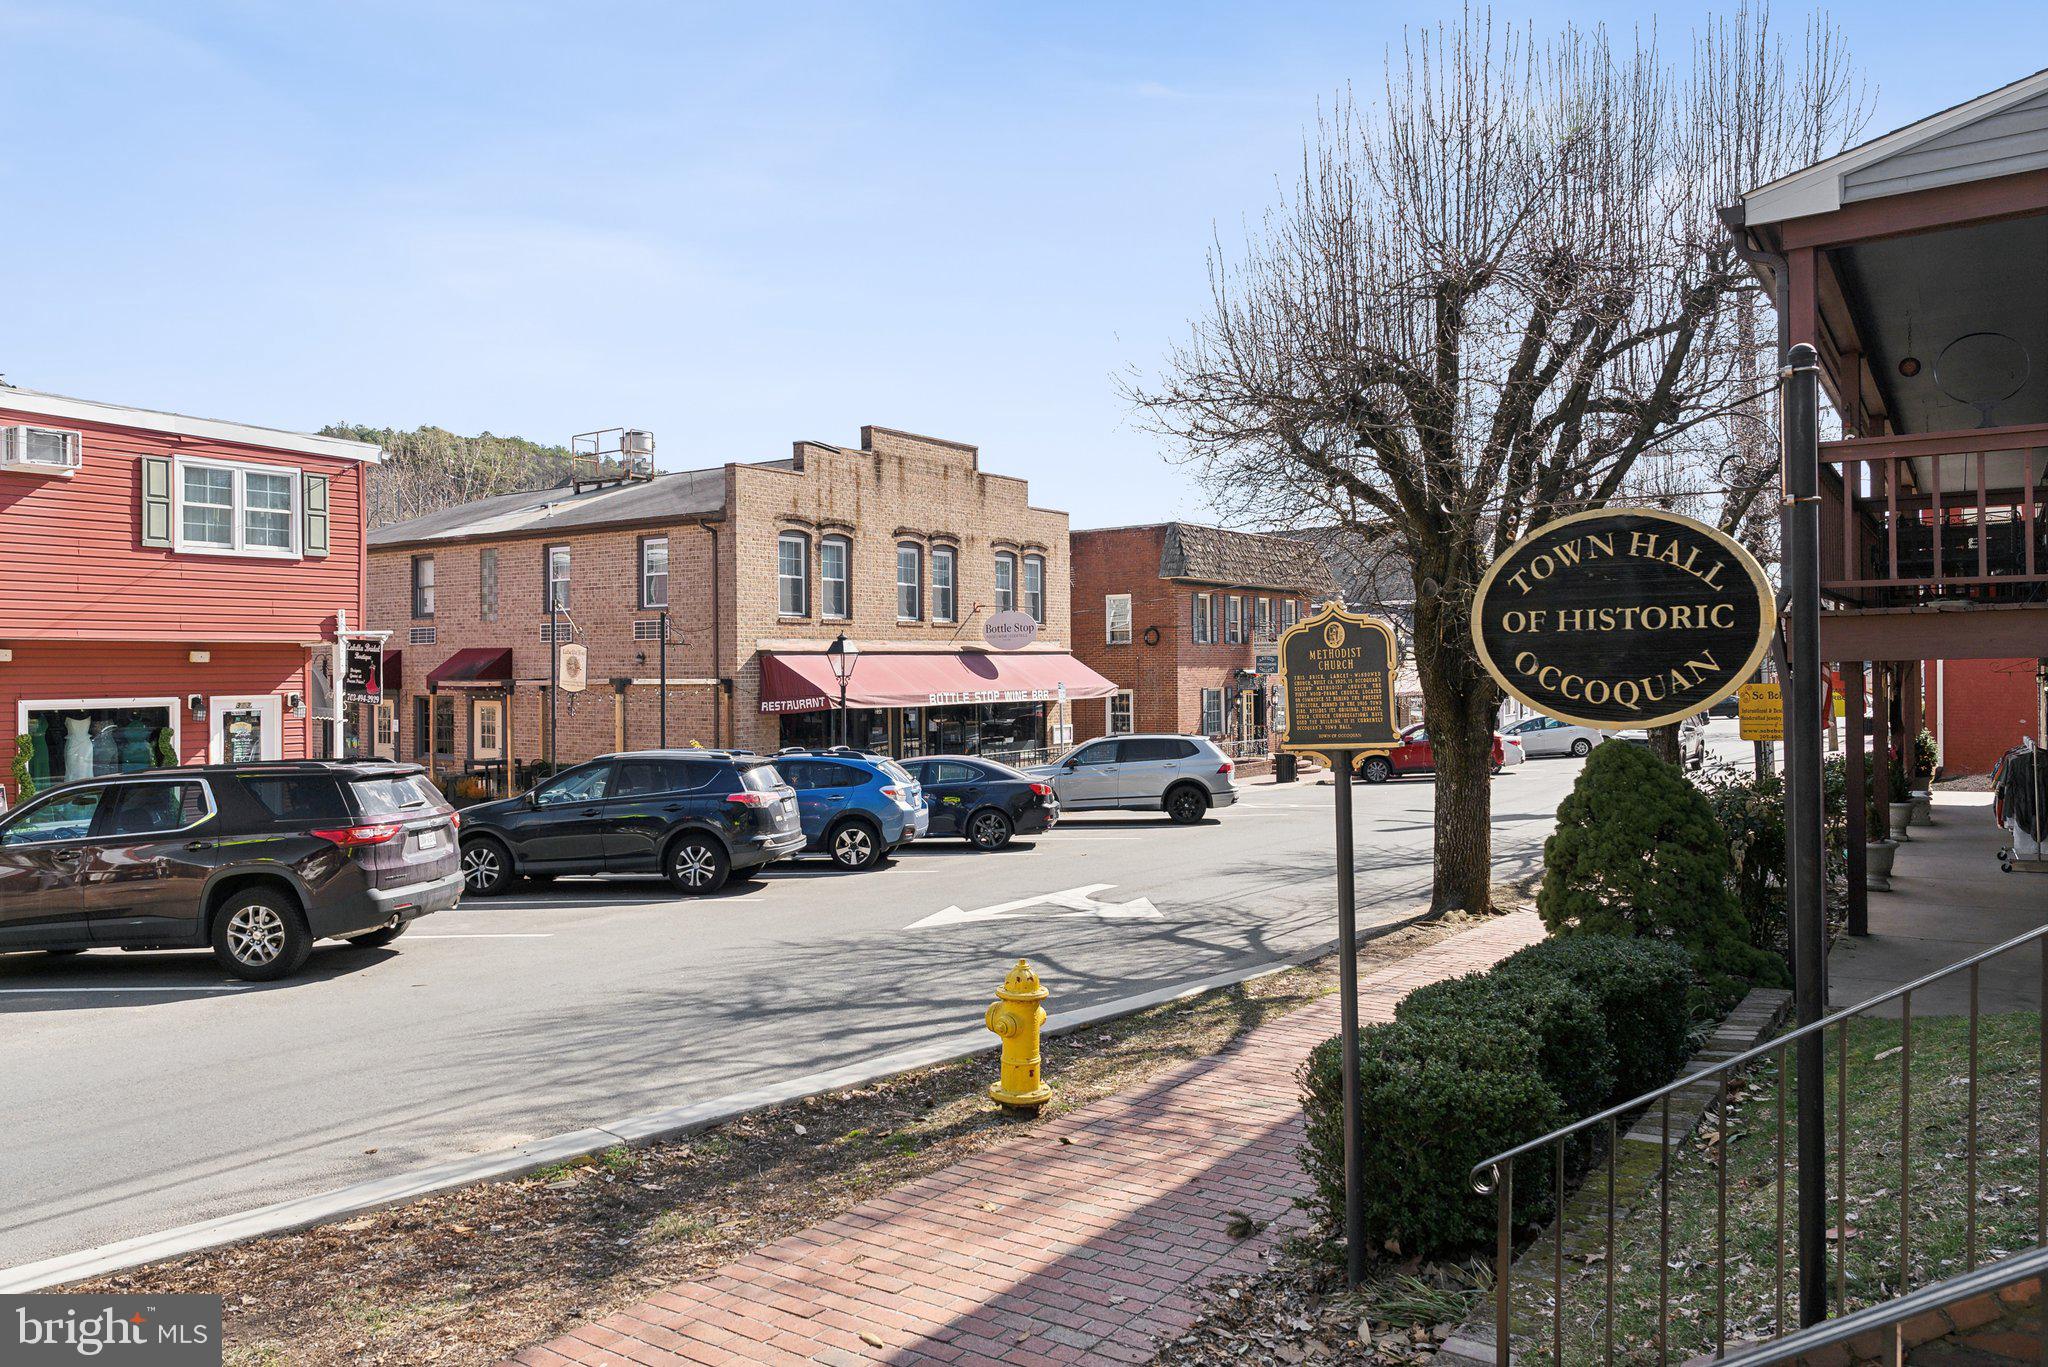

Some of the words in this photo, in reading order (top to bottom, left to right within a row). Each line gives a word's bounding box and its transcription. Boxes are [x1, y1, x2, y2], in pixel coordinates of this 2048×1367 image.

[1507, 532, 1614, 595] TOWN
[1629, 531, 1725, 592] HALL
[1502, 610, 1546, 633] OF
[1557, 604, 1734, 632] HISTORIC
[986, 624, 1012, 633] Bottle
[1014, 622, 1034, 634] Stop
[1309, 647, 1362, 660] METHODIST
[1318, 659, 1354, 671] CHURCH
[1515, 649, 1720, 710] OCCOQUAN
[929, 692, 971, 705] BOTTLE
[975, 690, 1000, 702] STOP
[1004, 690, 1028, 701] WINE
[1032, 690, 1050, 700] BAR
[1752, 692, 1764, 700] So
[761, 697, 826, 712] RESTAURANT
